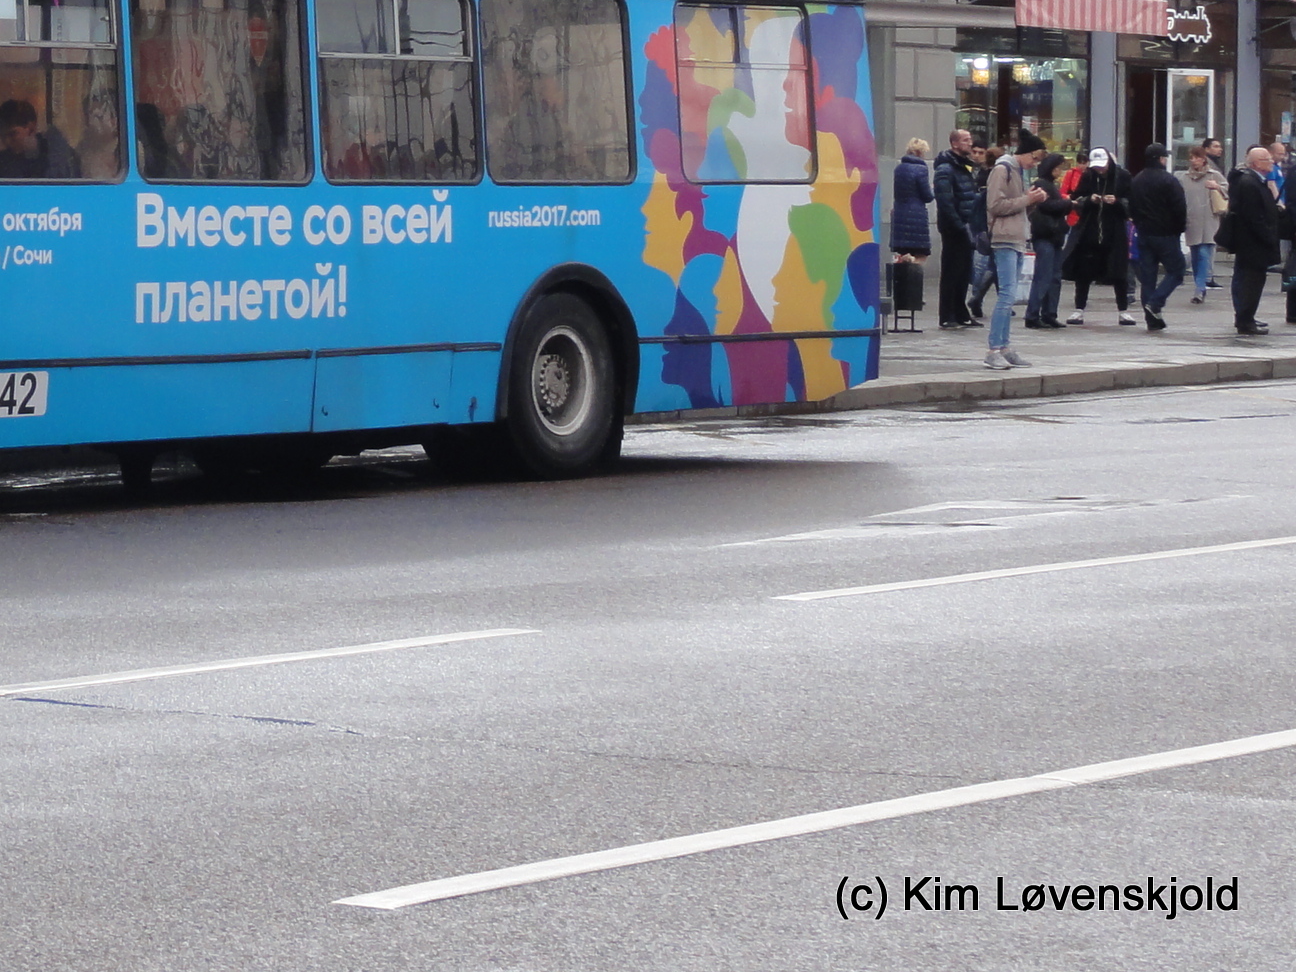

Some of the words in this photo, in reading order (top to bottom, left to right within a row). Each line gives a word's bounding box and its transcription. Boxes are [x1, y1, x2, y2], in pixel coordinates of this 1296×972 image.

[3, 206, 82, 237] октября
[136, 193, 292, 247] Вместе
[303, 204, 351, 246] со
[362, 189, 452, 244] всей
[488, 205, 601, 229] russia2017.com
[13, 245, 53, 265] Сочи
[135, 262, 347, 324] планетой!
